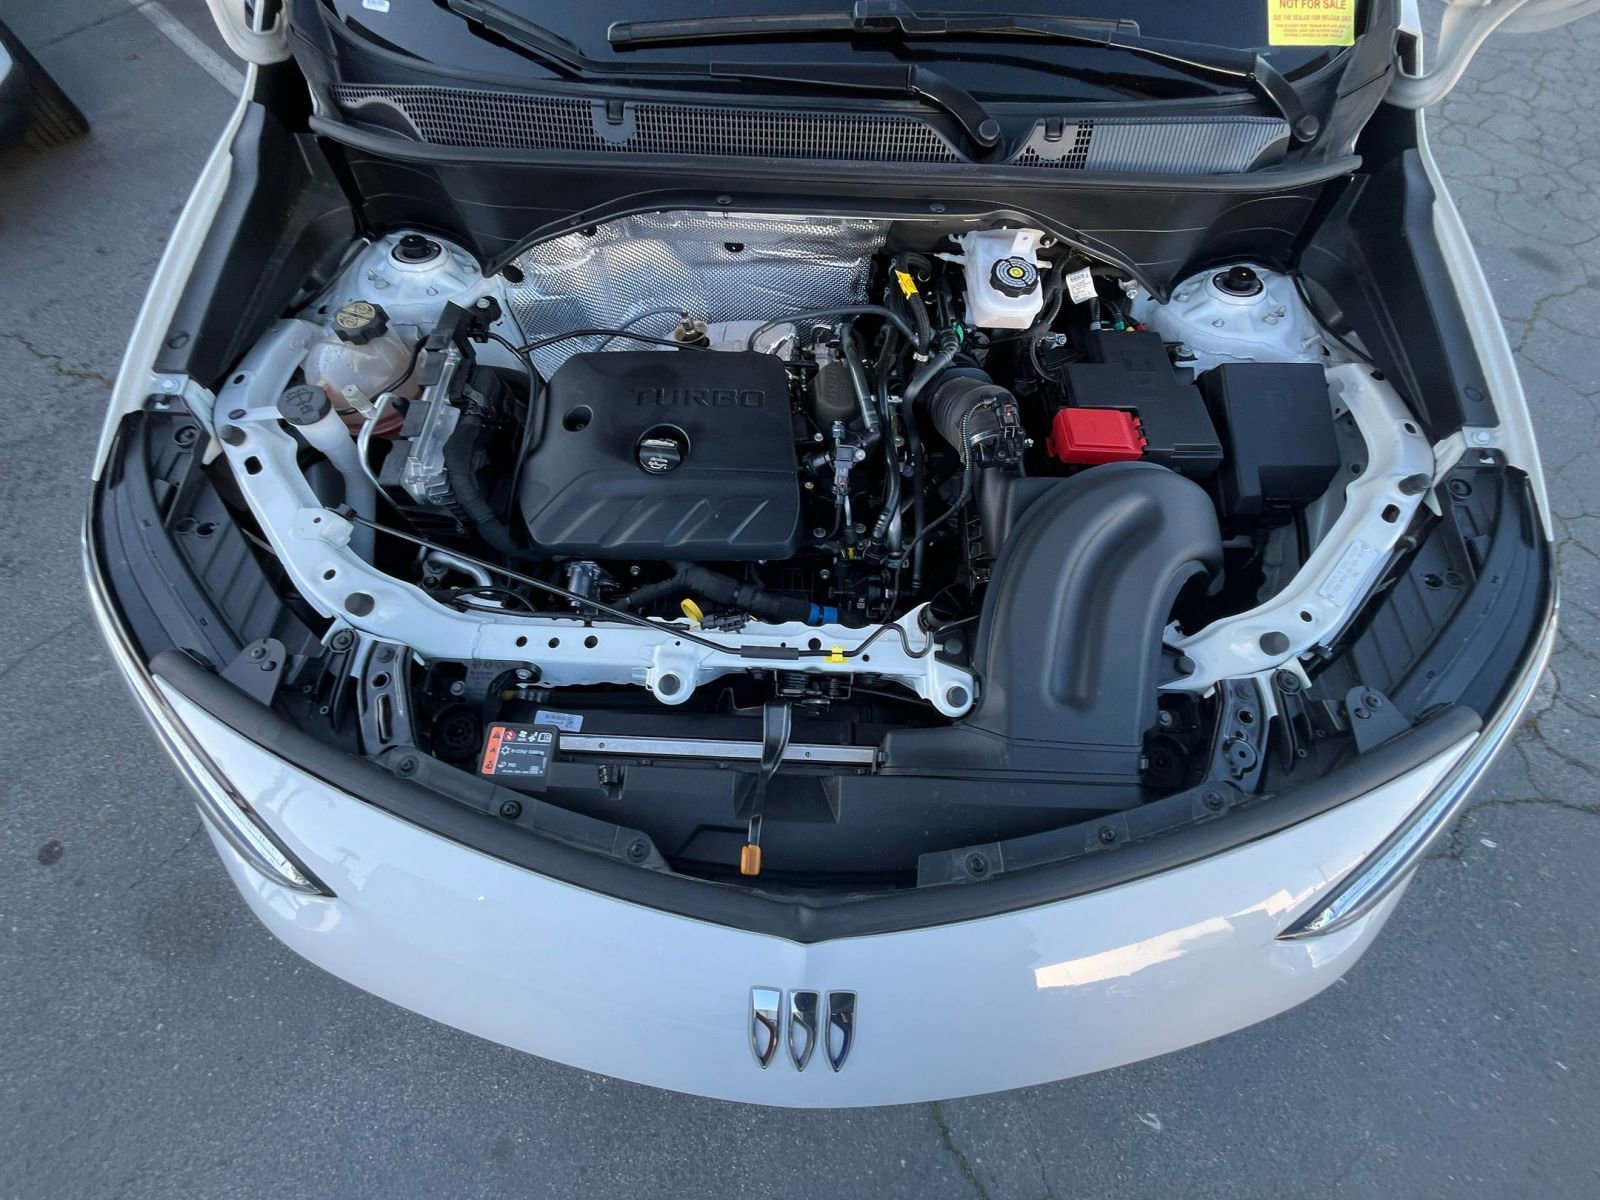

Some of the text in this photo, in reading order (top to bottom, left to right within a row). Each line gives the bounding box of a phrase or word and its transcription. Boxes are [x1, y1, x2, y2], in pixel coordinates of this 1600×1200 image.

[1279, 0, 1347, 10] NOT FOR SALE
[630, 387, 766, 408] TURBO
